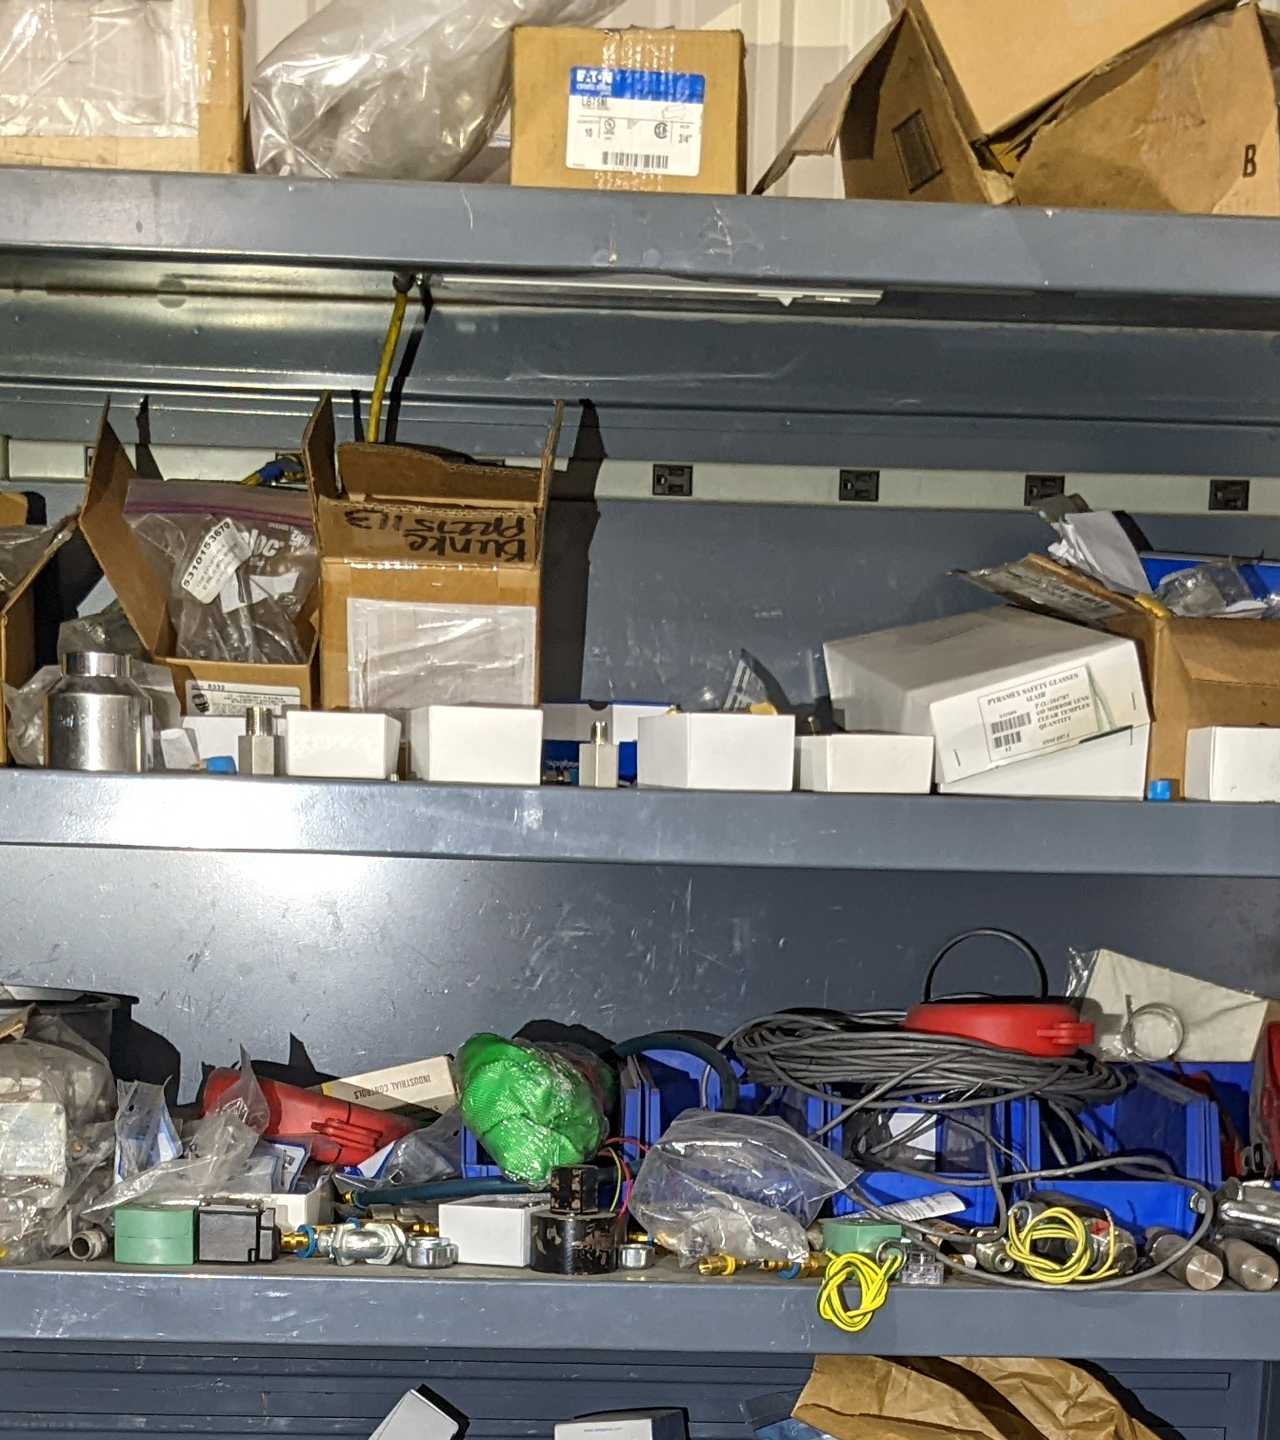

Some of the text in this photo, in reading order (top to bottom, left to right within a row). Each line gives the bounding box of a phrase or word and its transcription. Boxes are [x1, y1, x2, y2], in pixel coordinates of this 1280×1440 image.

[1242, 143, 1257, 178] B
[1022, 681, 1048, 696] SAFETY
[353, 1074, 432, 1100] INDUSTRIAL CONTROLS
